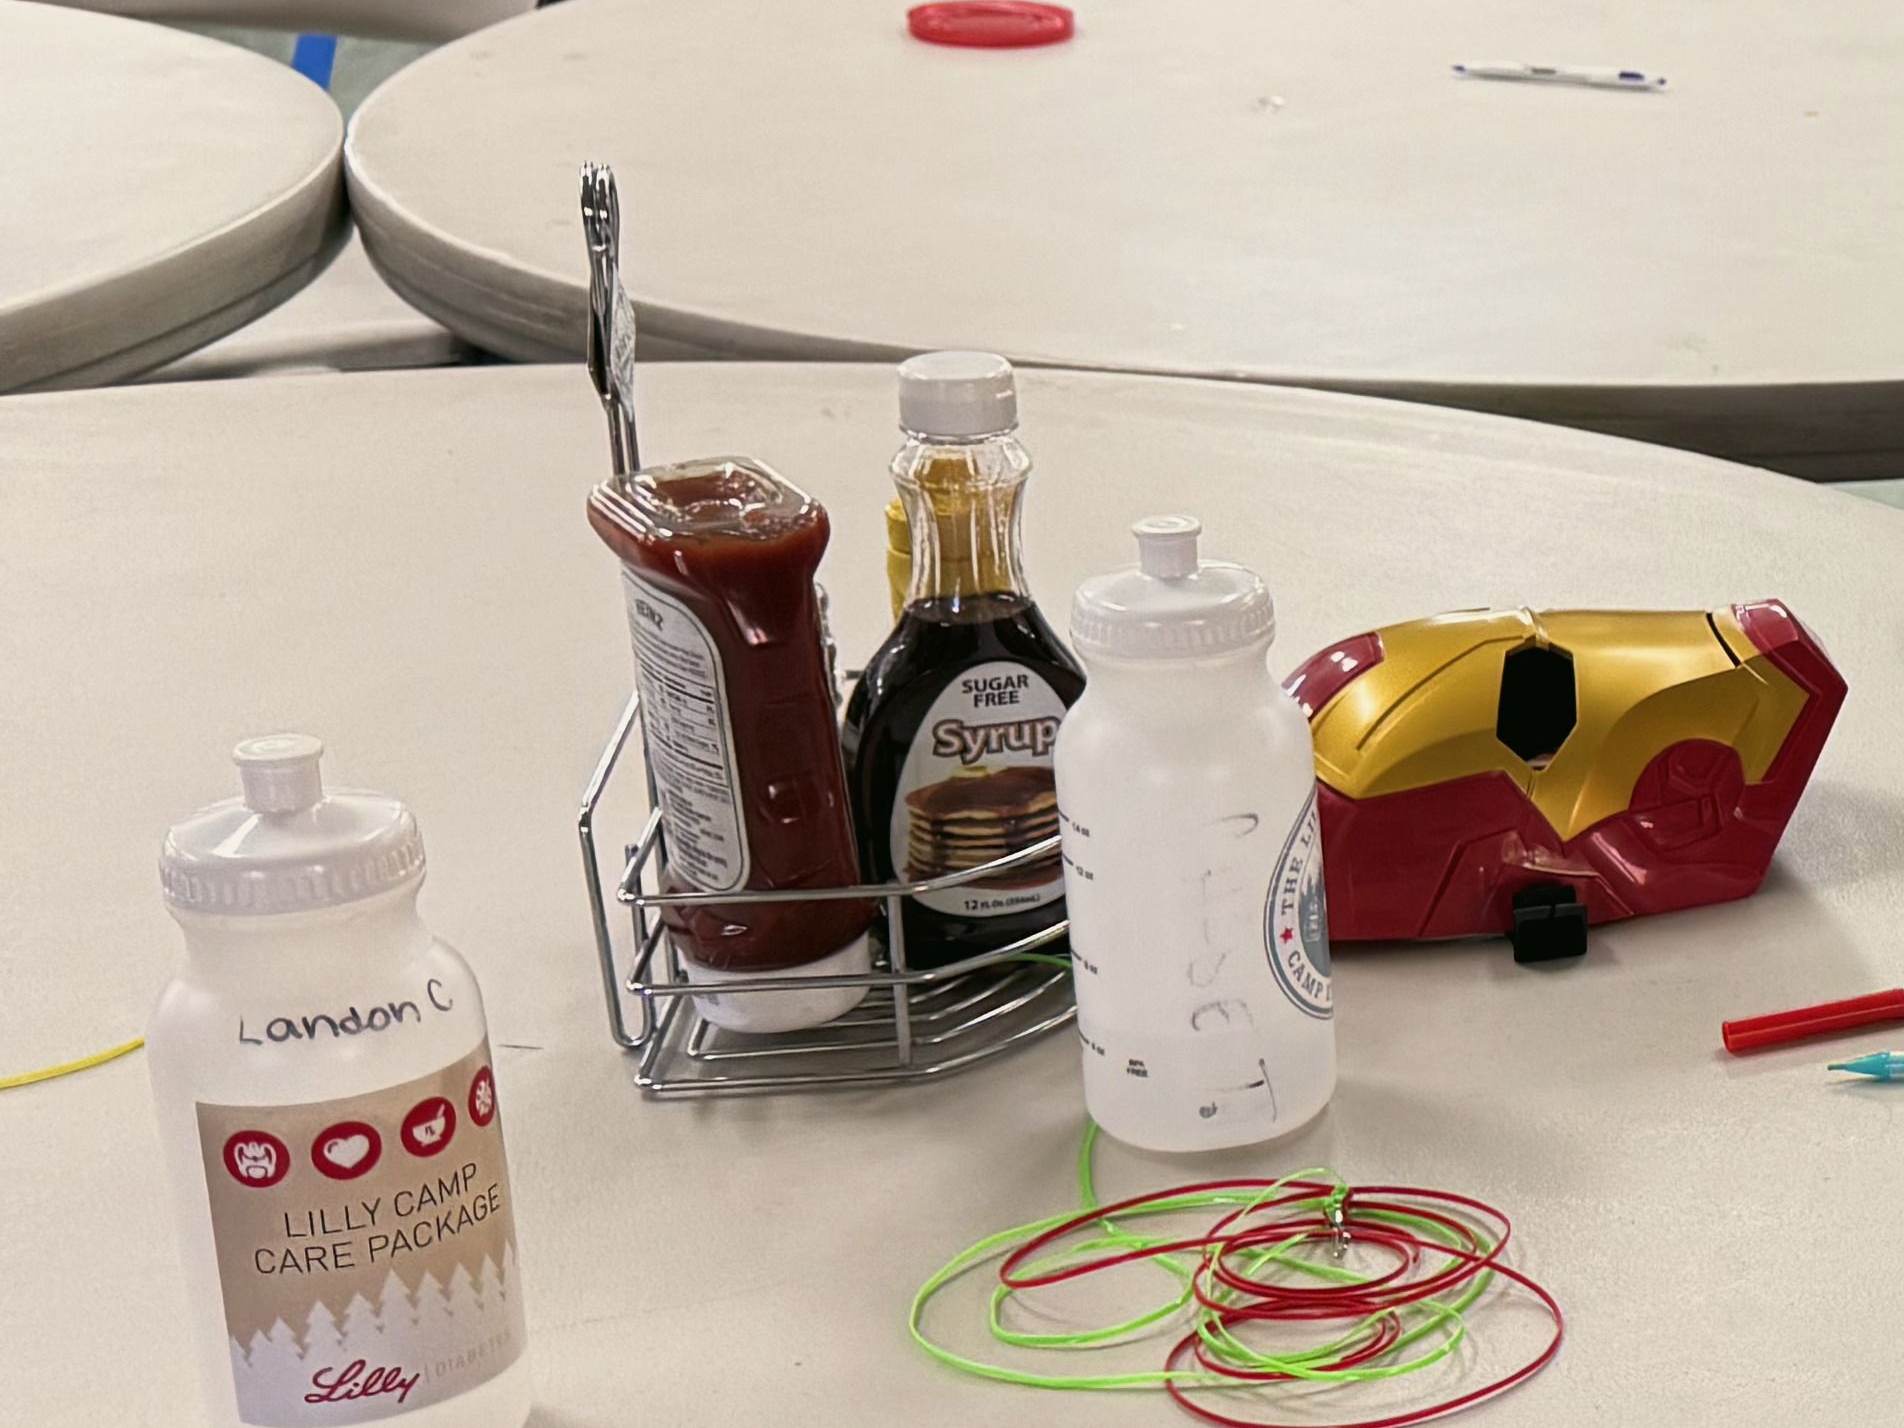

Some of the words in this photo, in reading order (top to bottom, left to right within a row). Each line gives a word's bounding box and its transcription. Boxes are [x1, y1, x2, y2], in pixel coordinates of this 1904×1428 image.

[962, 674, 1029, 694] SUGAR
[974, 690, 1020, 708] FREE
[933, 716, 1061, 765] Syrup
[964, 899, 978, 910] 12
[1281, 856, 1304, 917] THE
[1288, 950, 1323, 999] CAMP
[238, 1000, 422, 1046] Landon
[426, 977, 454, 1012] C
[284, 1197, 382, 1238] LILLY
[393, 1162, 478, 1218] CAMP
[254, 1240, 356, 1276] CARE
[368, 1182, 501, 1264] PACKAGE
[304, 1358, 421, 1404] Lilly
